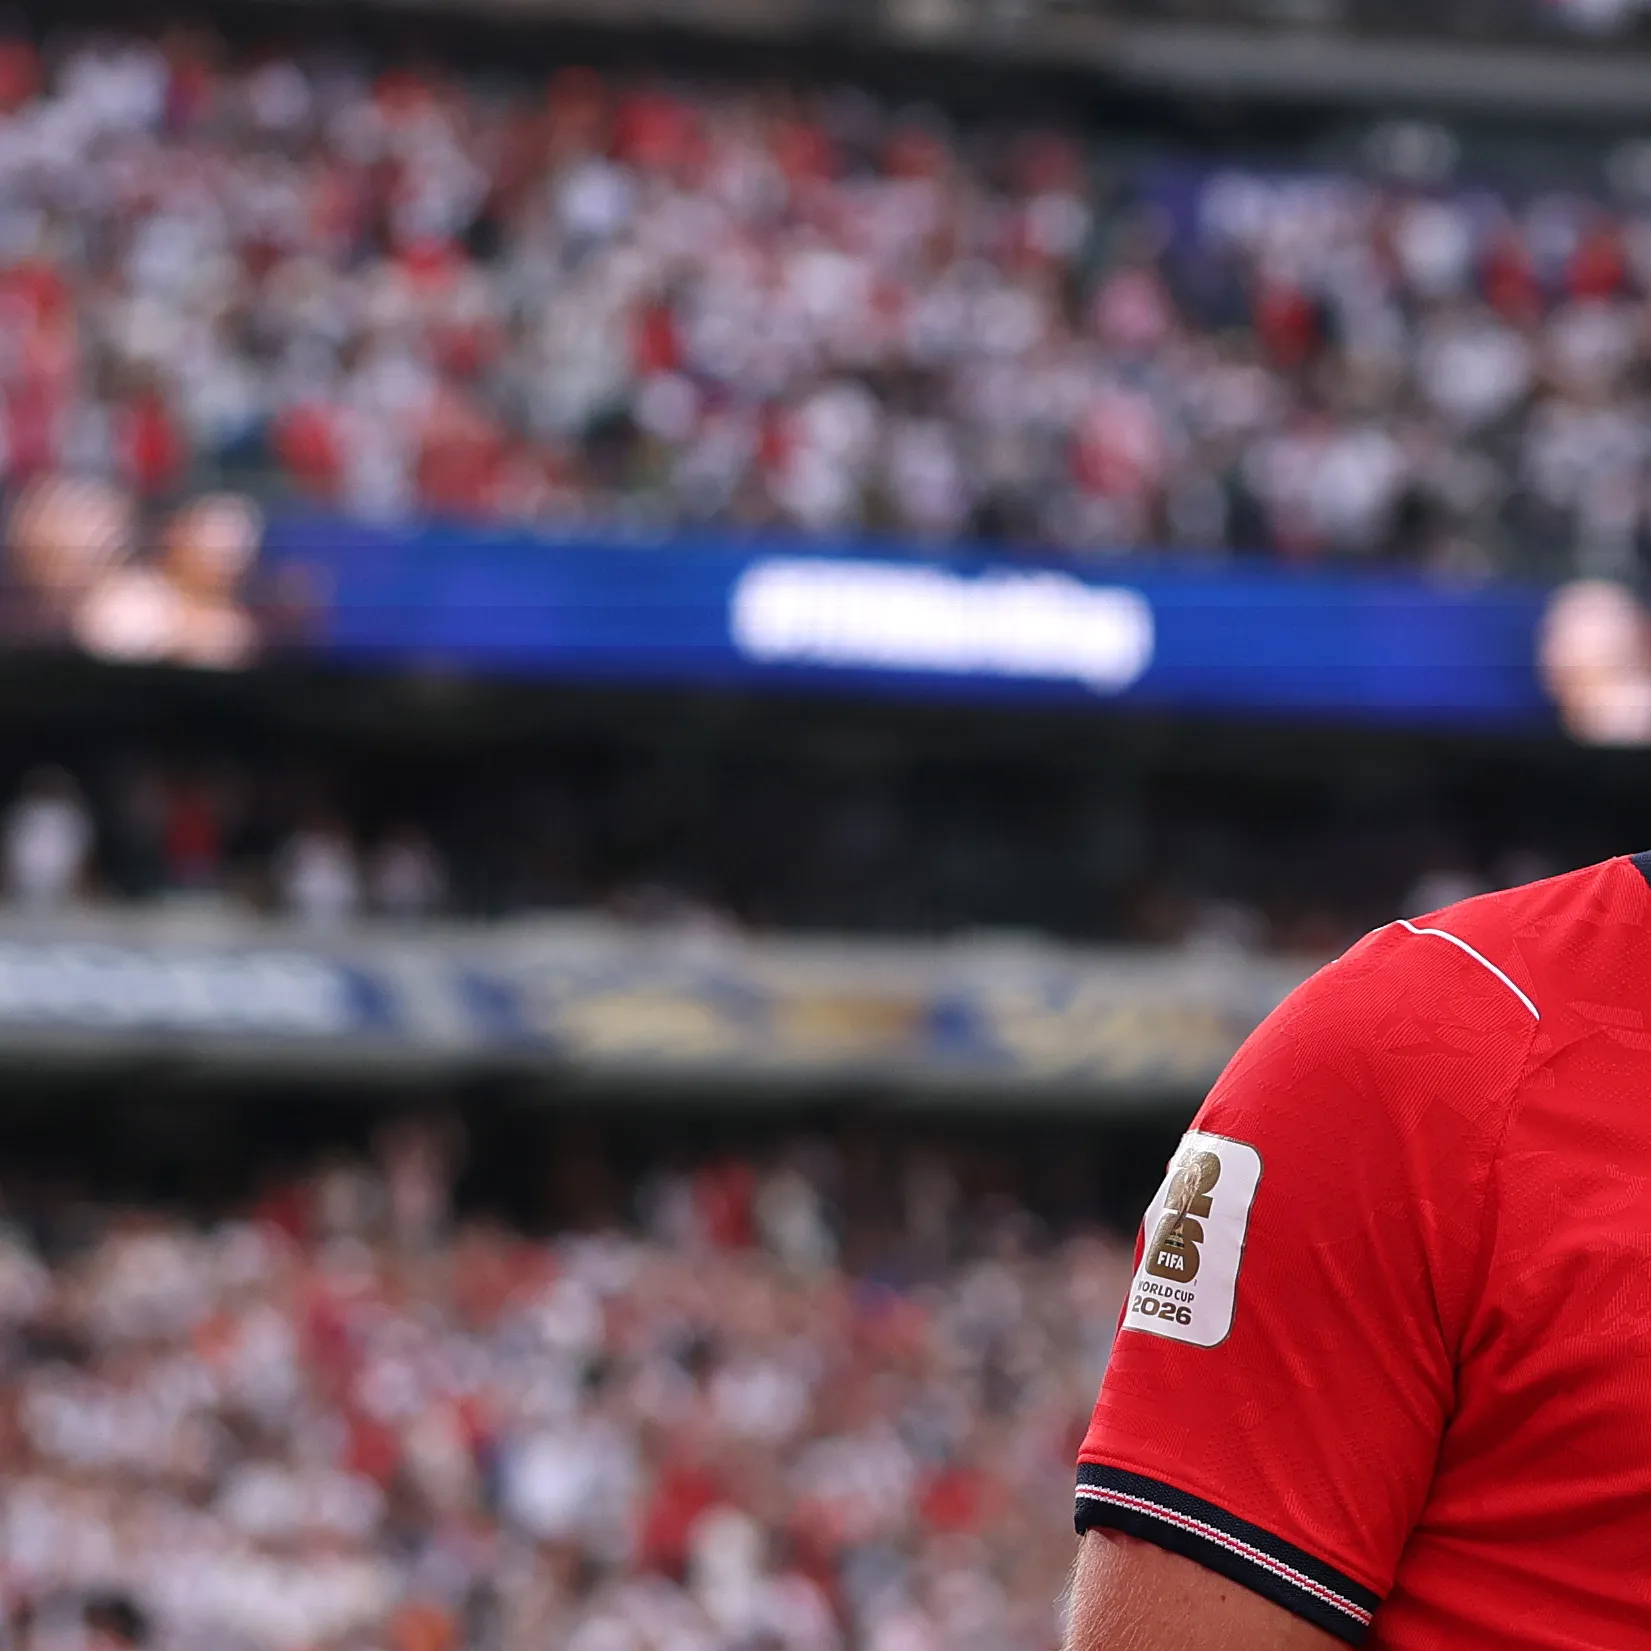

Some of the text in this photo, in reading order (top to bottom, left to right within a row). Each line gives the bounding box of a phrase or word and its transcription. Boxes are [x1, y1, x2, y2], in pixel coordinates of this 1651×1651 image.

[1157, 1250, 1185, 1272] FIFA
[1174, 1289, 1195, 1303] CUP
[1132, 1295, 1192, 1325] 2026
